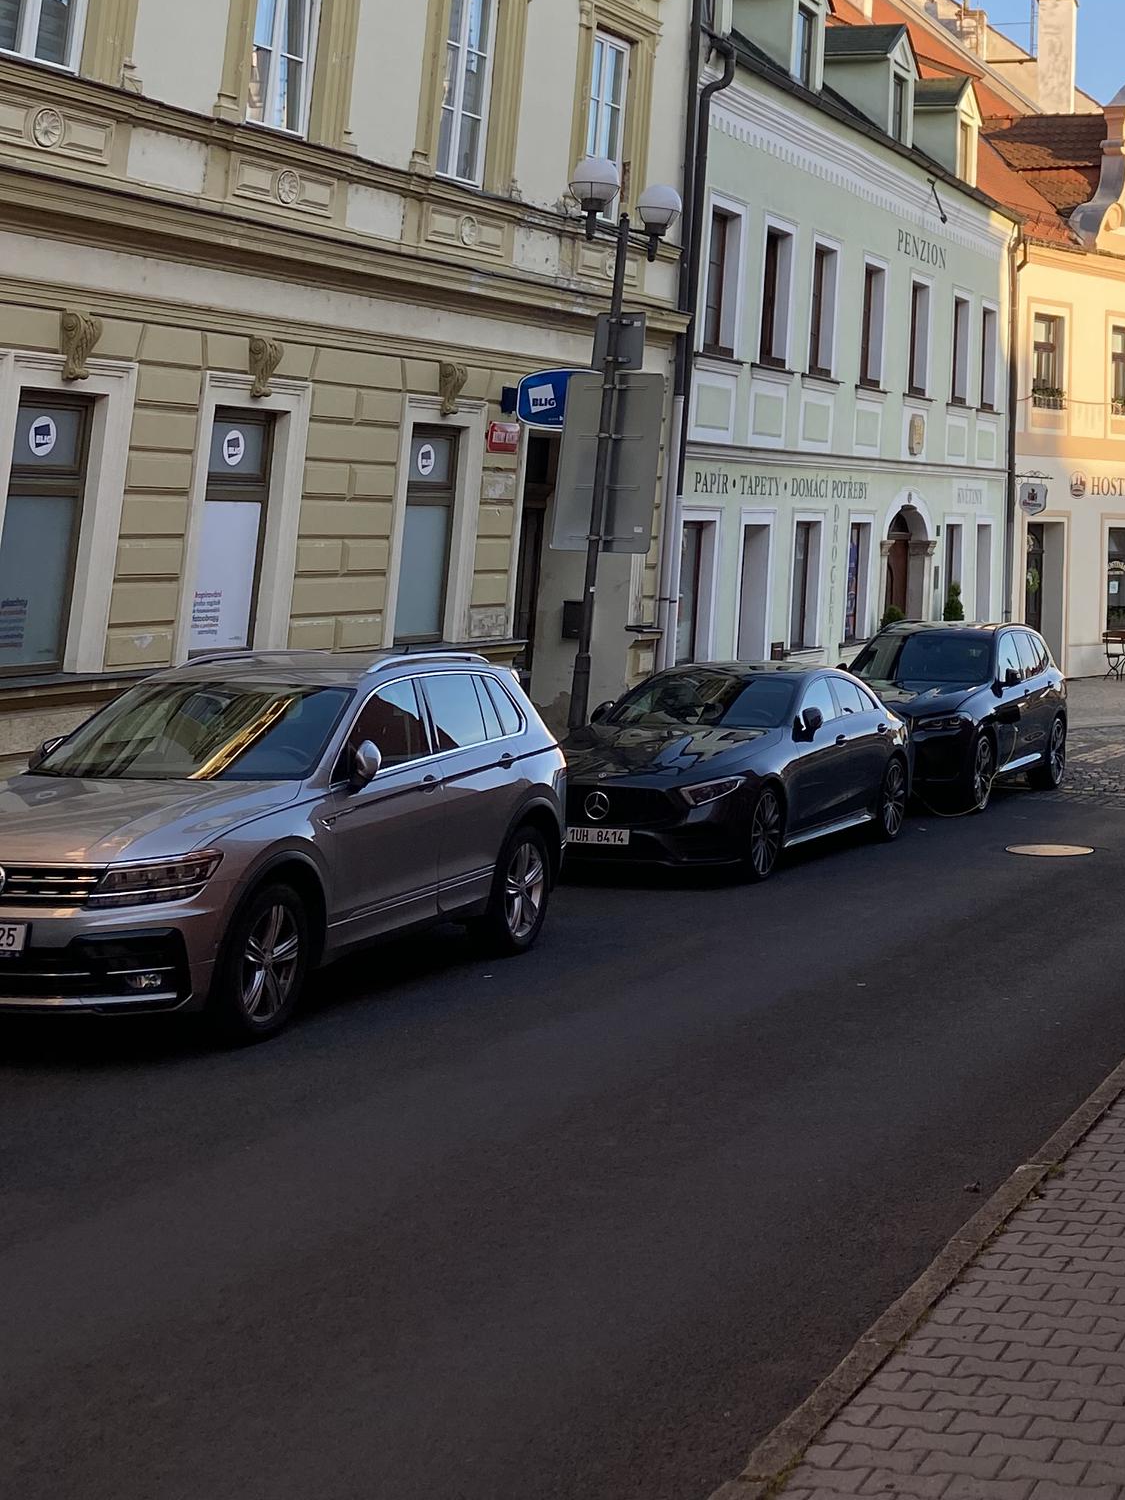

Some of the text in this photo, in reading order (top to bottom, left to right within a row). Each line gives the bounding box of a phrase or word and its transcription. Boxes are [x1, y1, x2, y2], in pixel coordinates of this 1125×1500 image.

[897, 228, 947, 270] PENZION
[532, 397, 556, 407] BLIG
[694, 467, 870, 500] PAPÍR TAPETY DOMÁCÍ POTŘEBY
[570, 828, 624, 843] 1UH 8414
